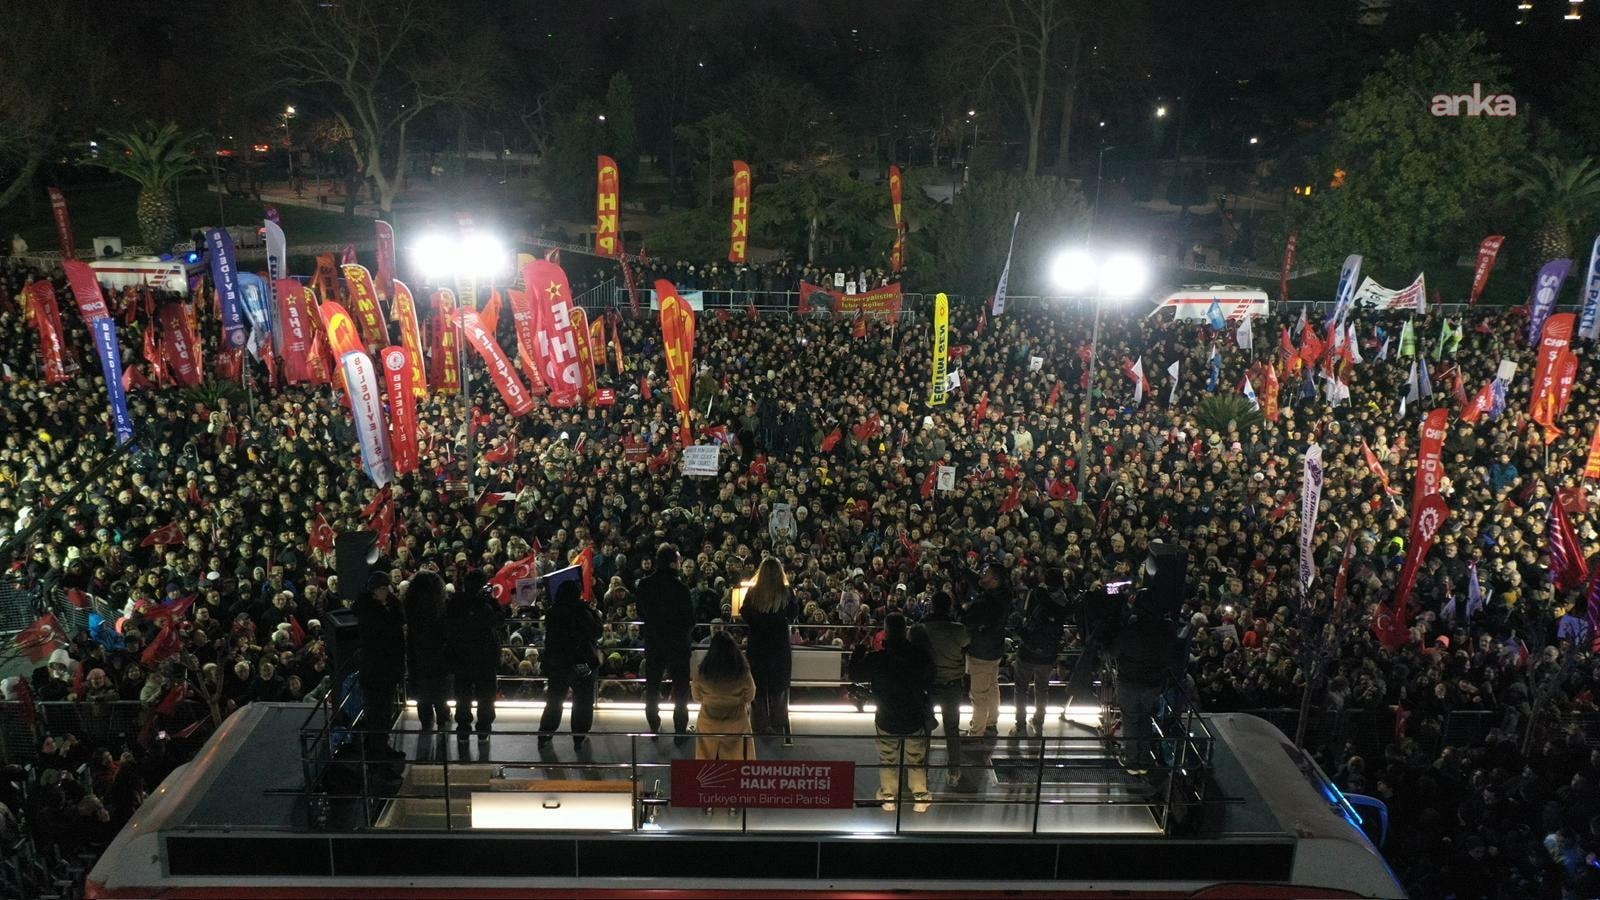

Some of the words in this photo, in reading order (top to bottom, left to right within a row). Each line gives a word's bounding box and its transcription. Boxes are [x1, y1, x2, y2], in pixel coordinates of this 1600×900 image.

[740, 763, 832, 777] CUMHURİYET
[740, 778, 776, 790] HALK
[780, 777, 831, 790] PARTİSİ
[698, 793, 757, 805] Türkiye'nin
[759, 793, 793, 804] Birinci
[796, 794, 831, 805] Partisi
